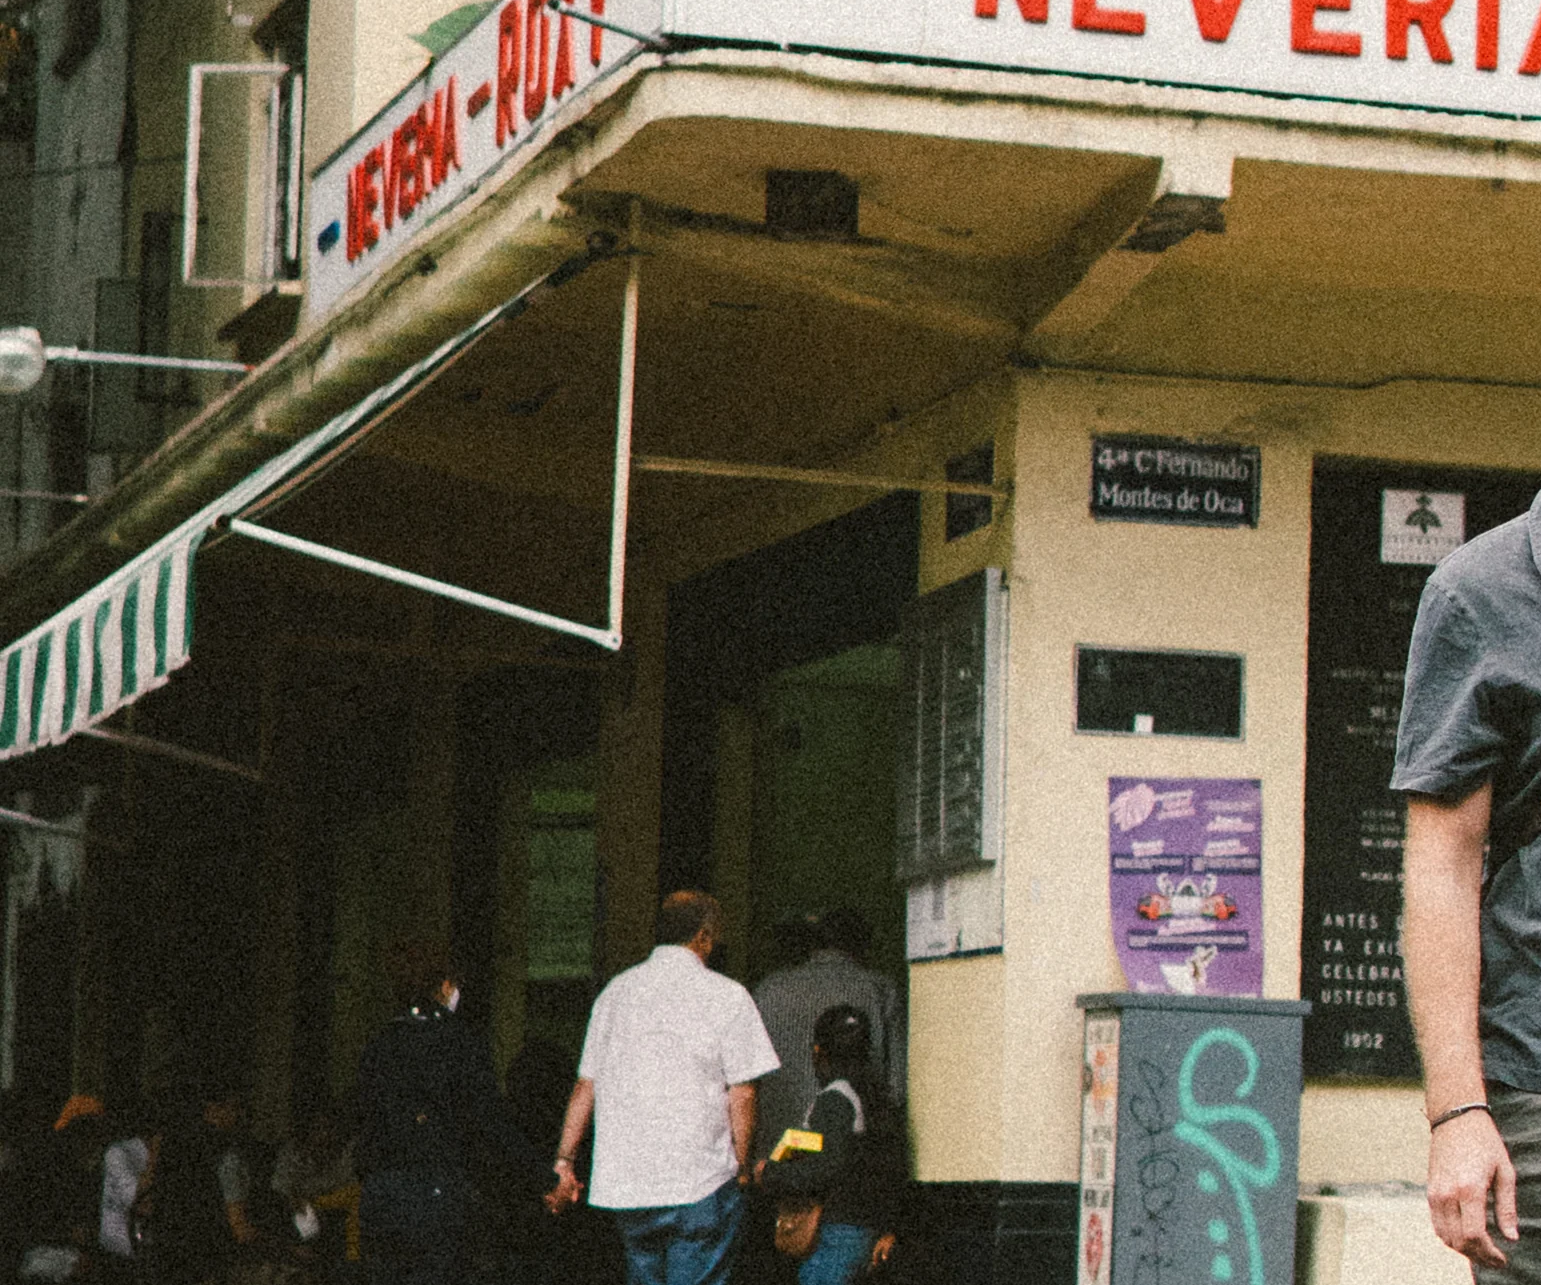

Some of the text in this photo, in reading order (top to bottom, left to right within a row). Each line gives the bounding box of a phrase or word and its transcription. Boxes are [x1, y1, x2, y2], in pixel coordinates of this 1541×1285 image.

[1156, 450, 1249, 480] Fernando
[1099, 483, 1244, 514] Montes de Oca
[1324, 914, 1378, 929] ANTES
[1324, 940, 1344, 952] YA
[1321, 991, 1398, 1007] USTEDES
